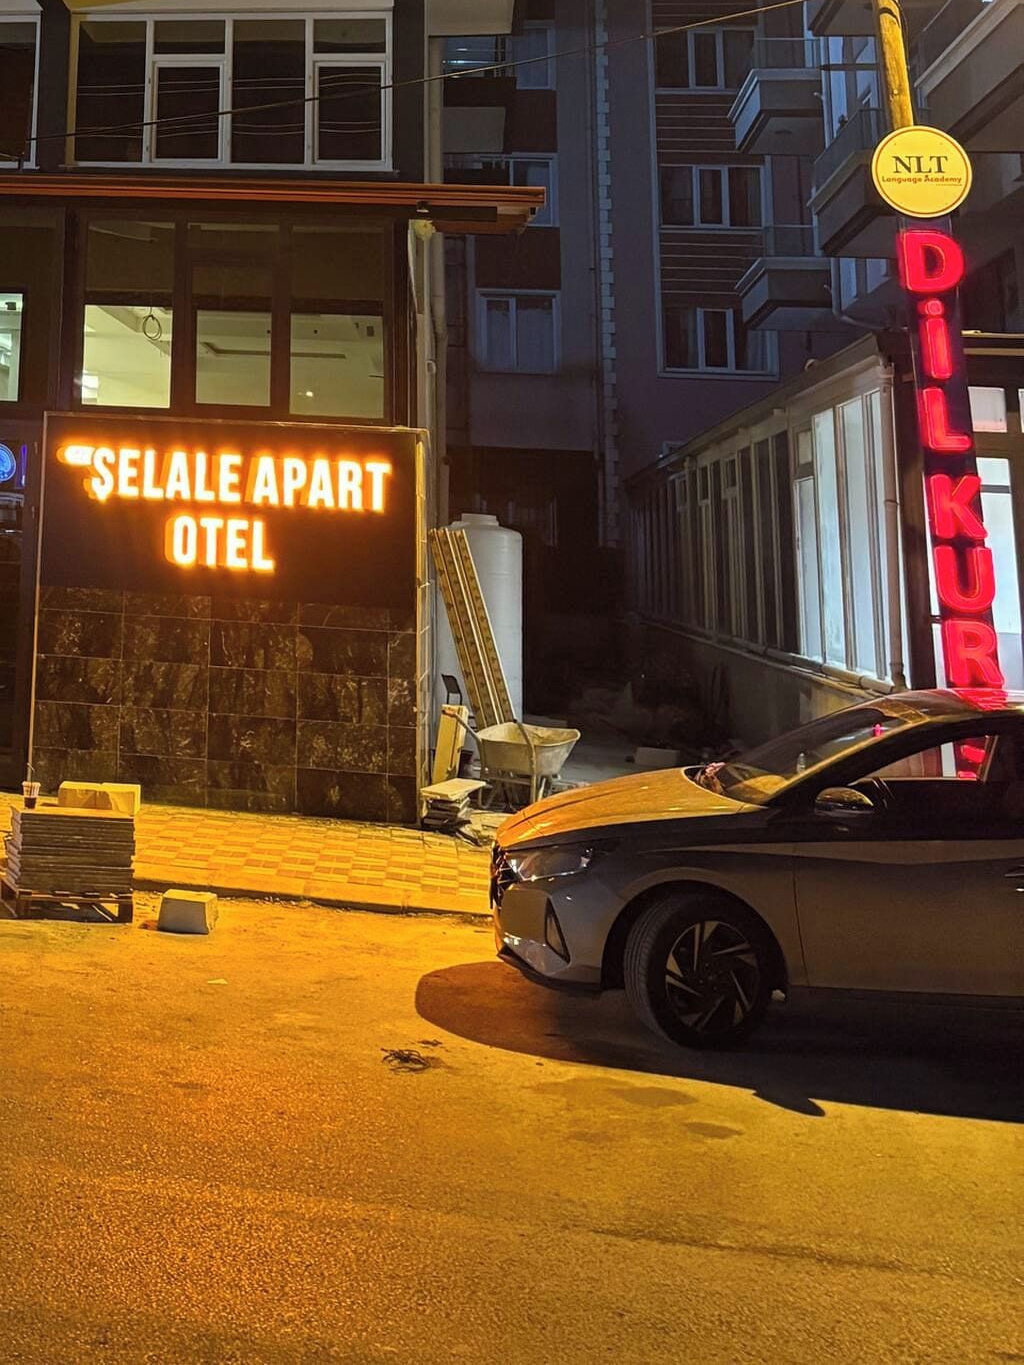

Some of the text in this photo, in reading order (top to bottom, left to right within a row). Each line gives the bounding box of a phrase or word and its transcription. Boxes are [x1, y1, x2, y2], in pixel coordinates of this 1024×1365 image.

[891, 155, 948, 174] NLT
[250, 456, 392, 512] APART
[166, 515, 276, 572] OTEL
